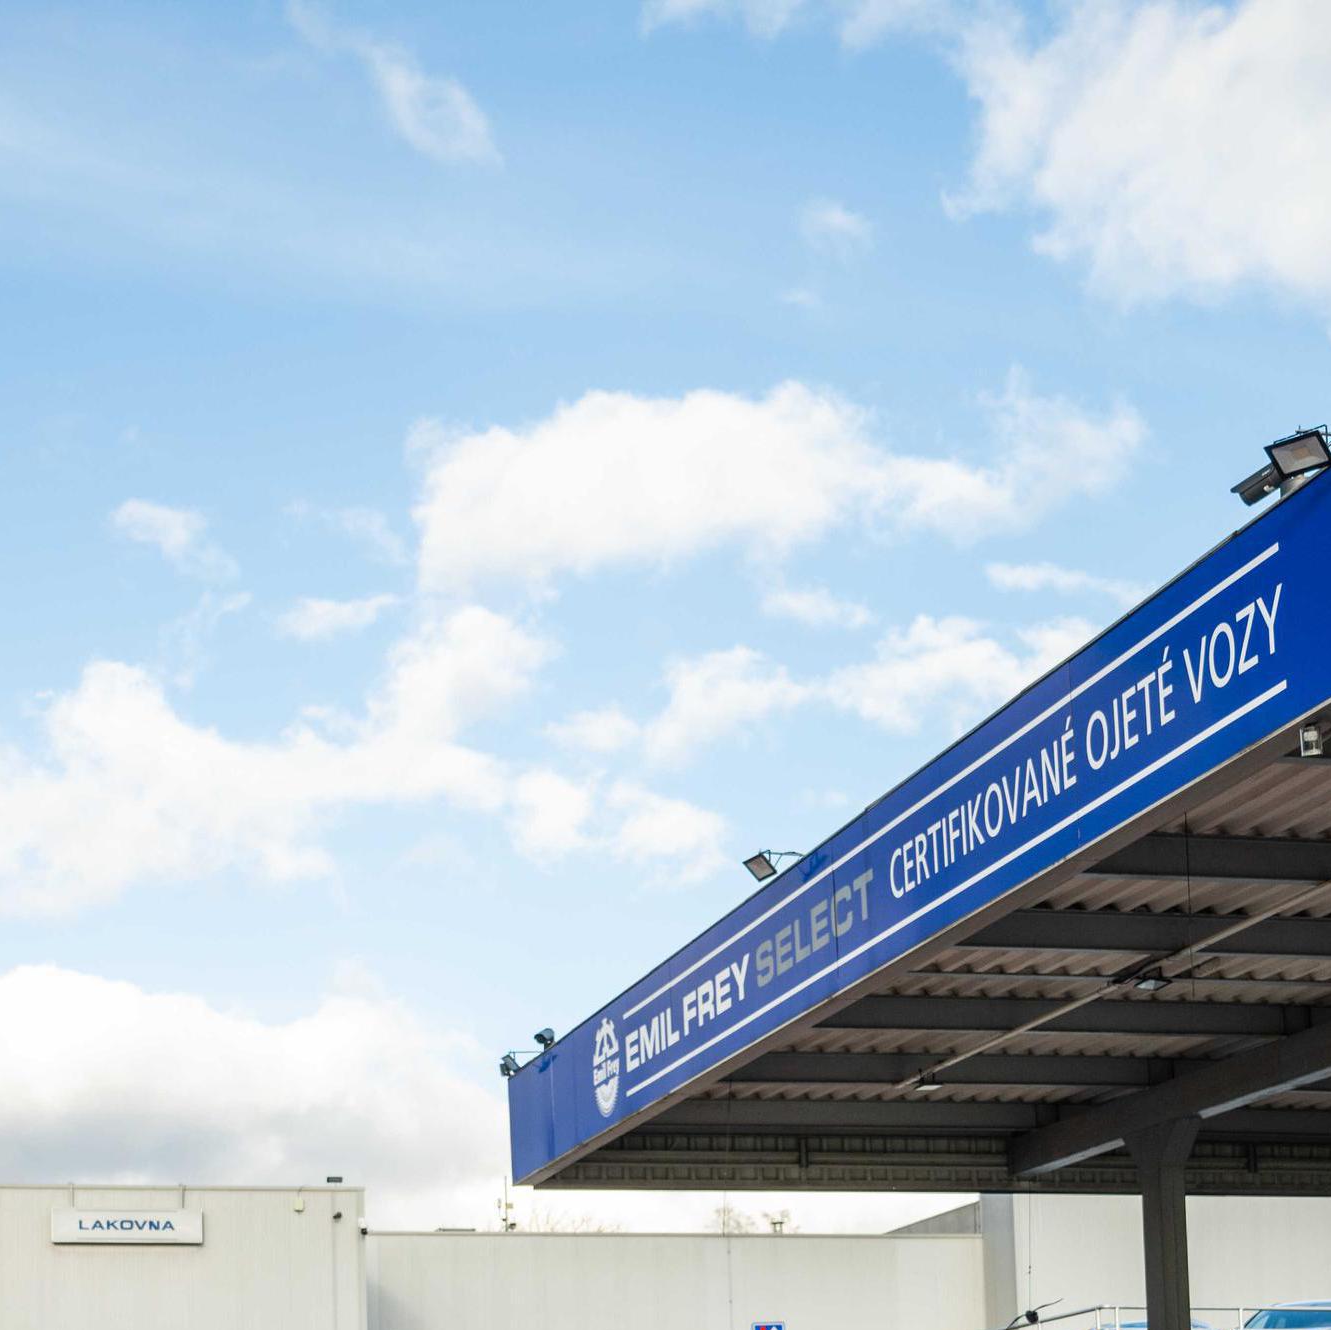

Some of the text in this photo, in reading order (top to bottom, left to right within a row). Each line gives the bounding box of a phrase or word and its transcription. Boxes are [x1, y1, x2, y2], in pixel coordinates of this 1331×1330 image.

[889, 582, 1284, 900] CERTIFIKOVANÉ OJETÉ VOZY
[625, 869, 875, 1073] EMIL FREY SELECT
[77, 1218, 176, 1232] LAKOVNA
